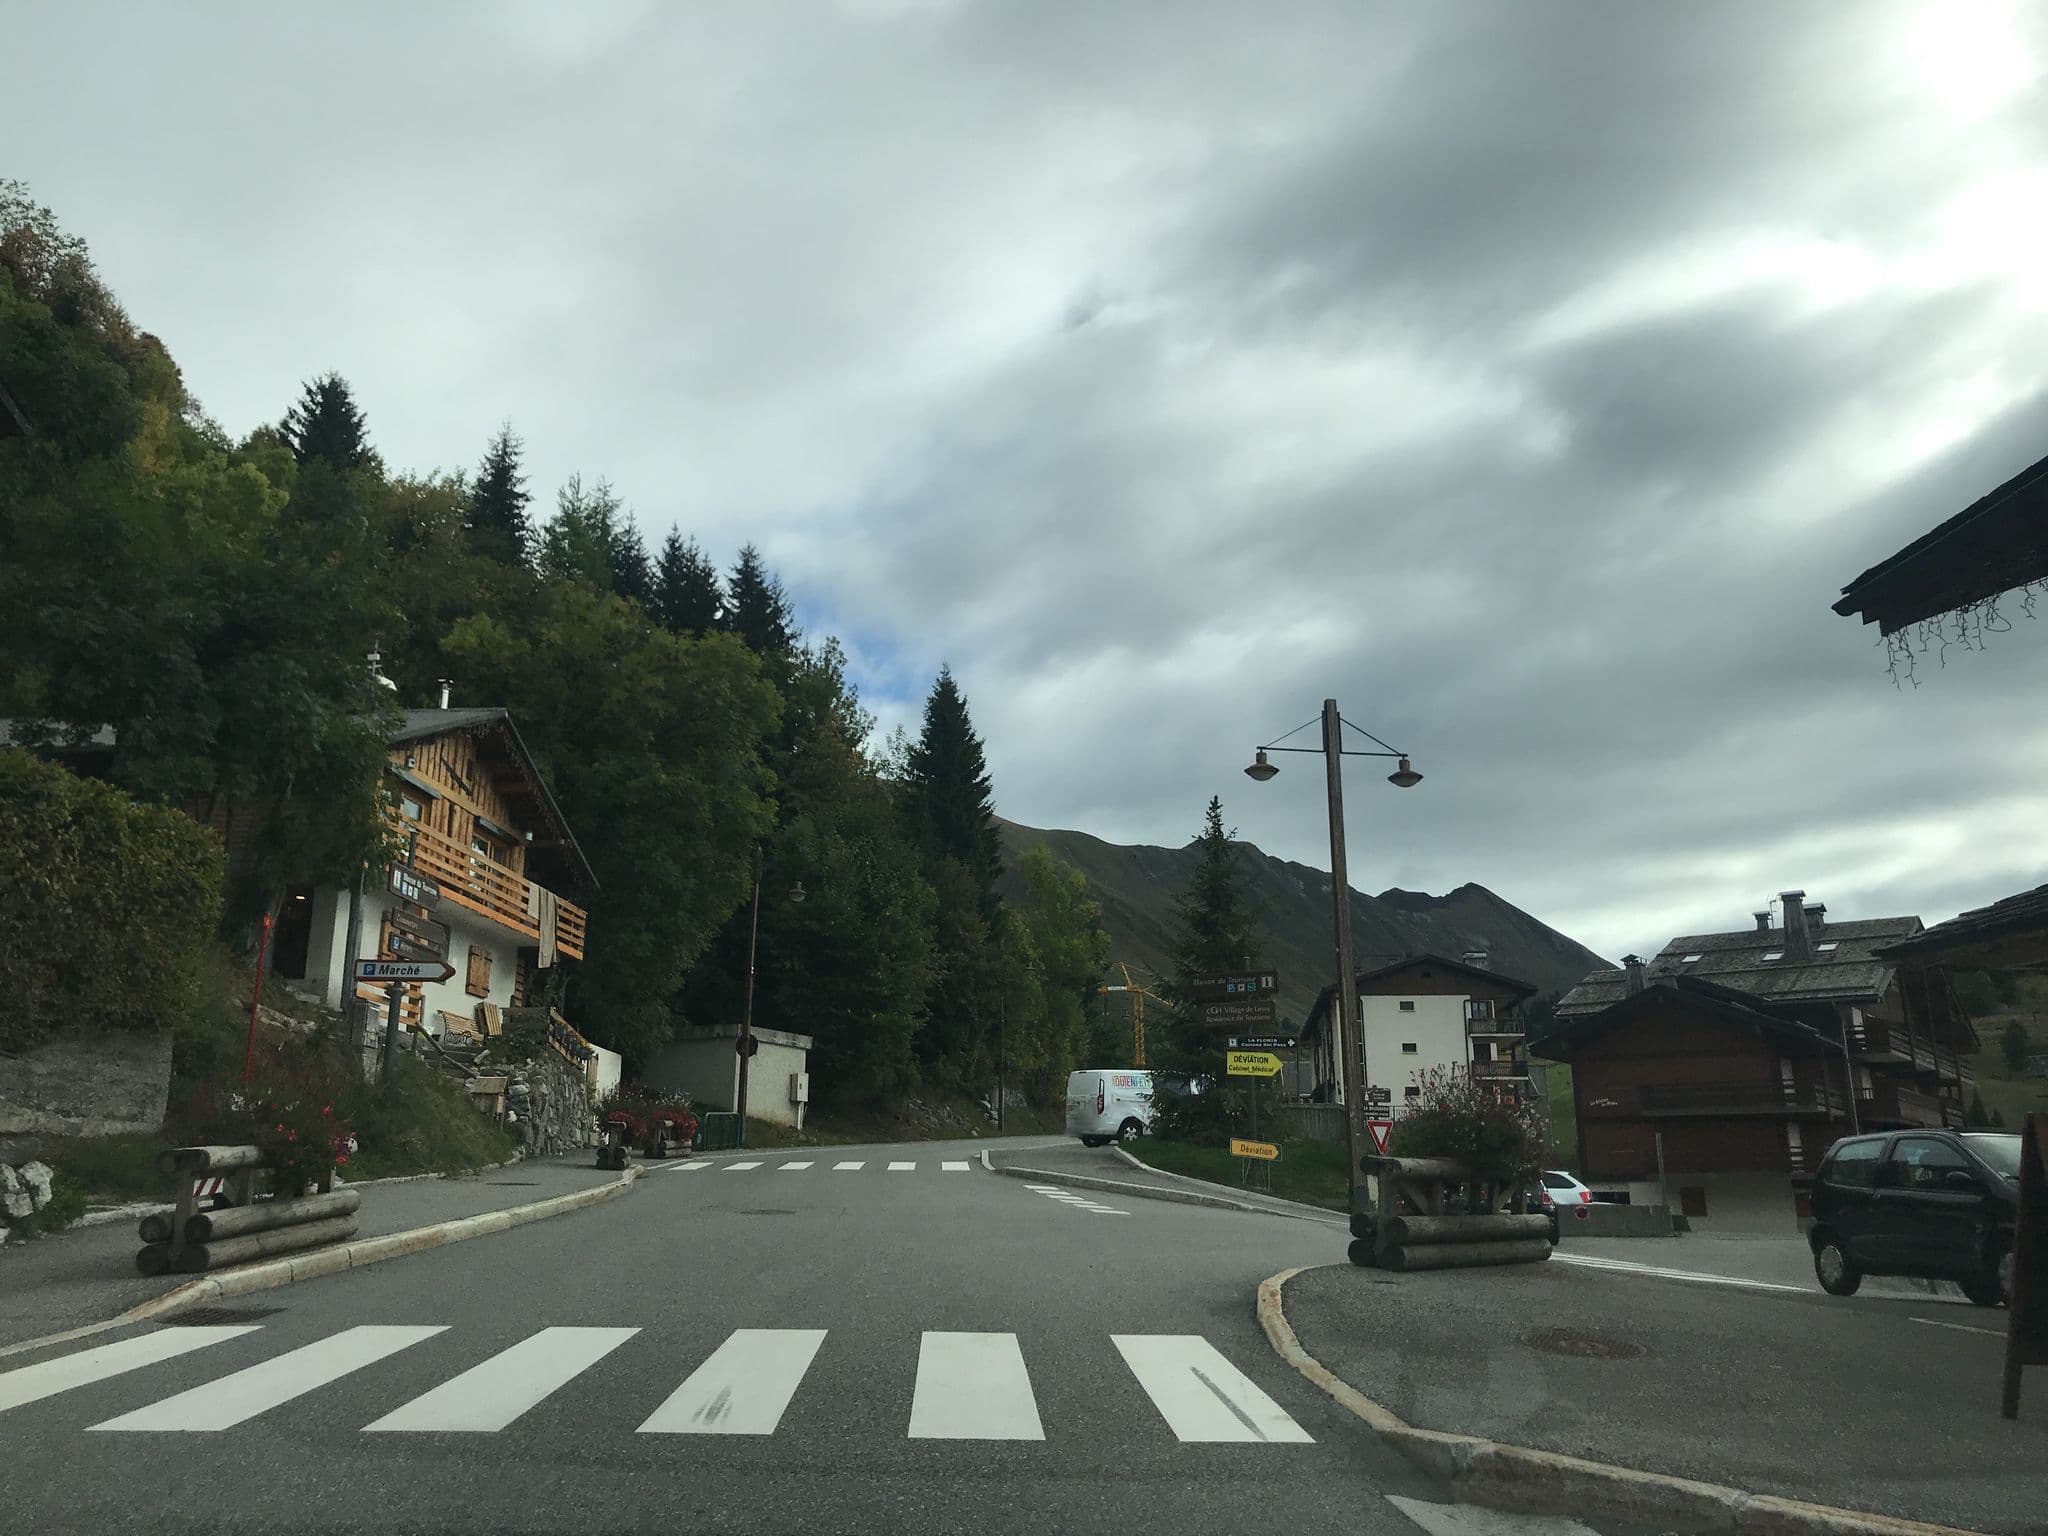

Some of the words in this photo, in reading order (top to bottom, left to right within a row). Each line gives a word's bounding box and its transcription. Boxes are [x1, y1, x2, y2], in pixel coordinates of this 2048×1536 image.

[378, 964, 420, 975] Marché
[1233, 1054, 1269, 1064] DÉVIATION
[1239, 1144, 1273, 1156] Déviation
